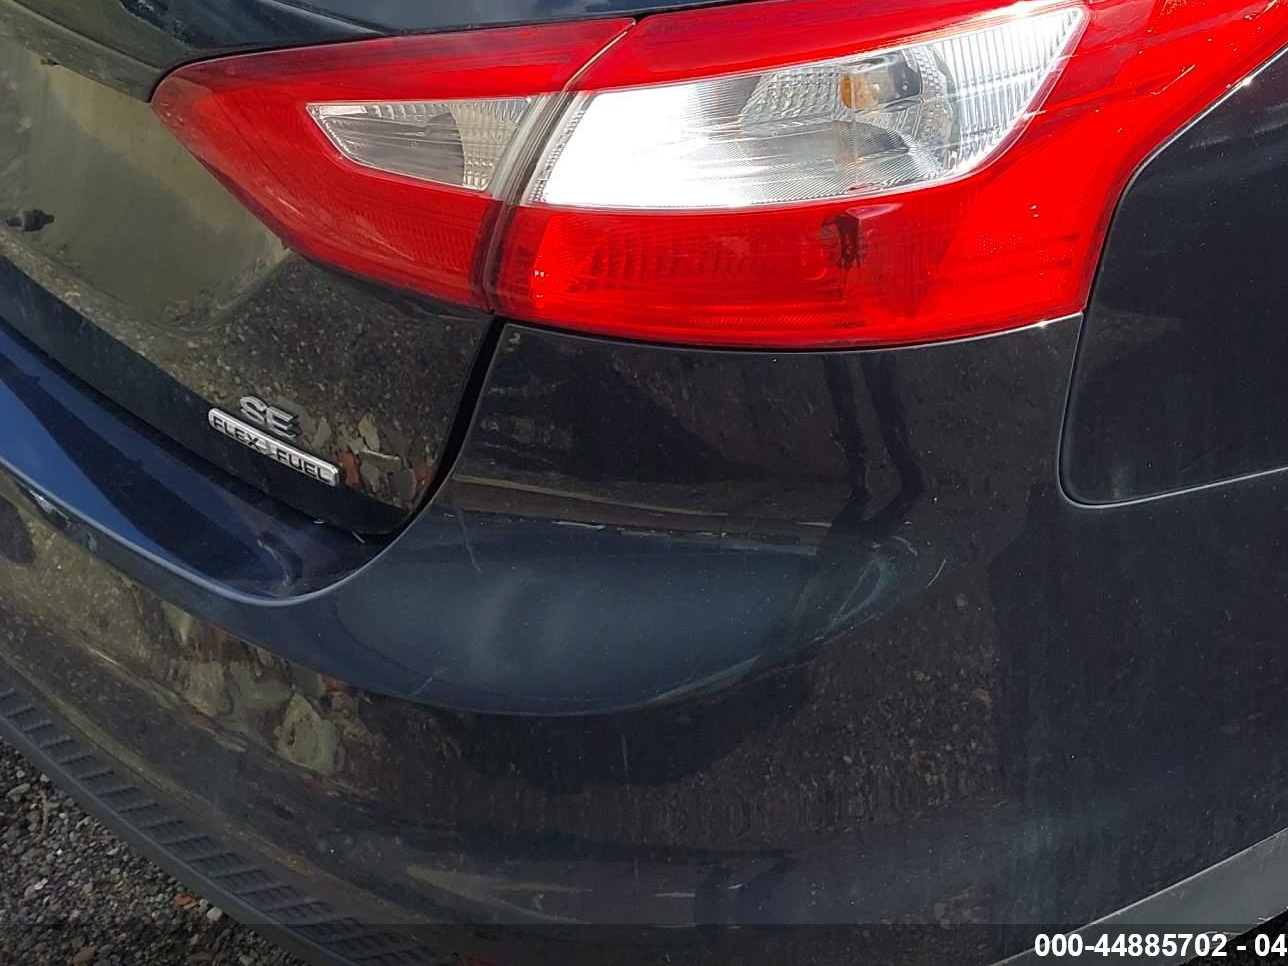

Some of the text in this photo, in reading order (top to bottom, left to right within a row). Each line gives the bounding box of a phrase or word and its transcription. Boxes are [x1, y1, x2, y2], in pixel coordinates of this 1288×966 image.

[239, 394, 299, 441] SE
[212, 415, 333, 486] FLEX FUEL
